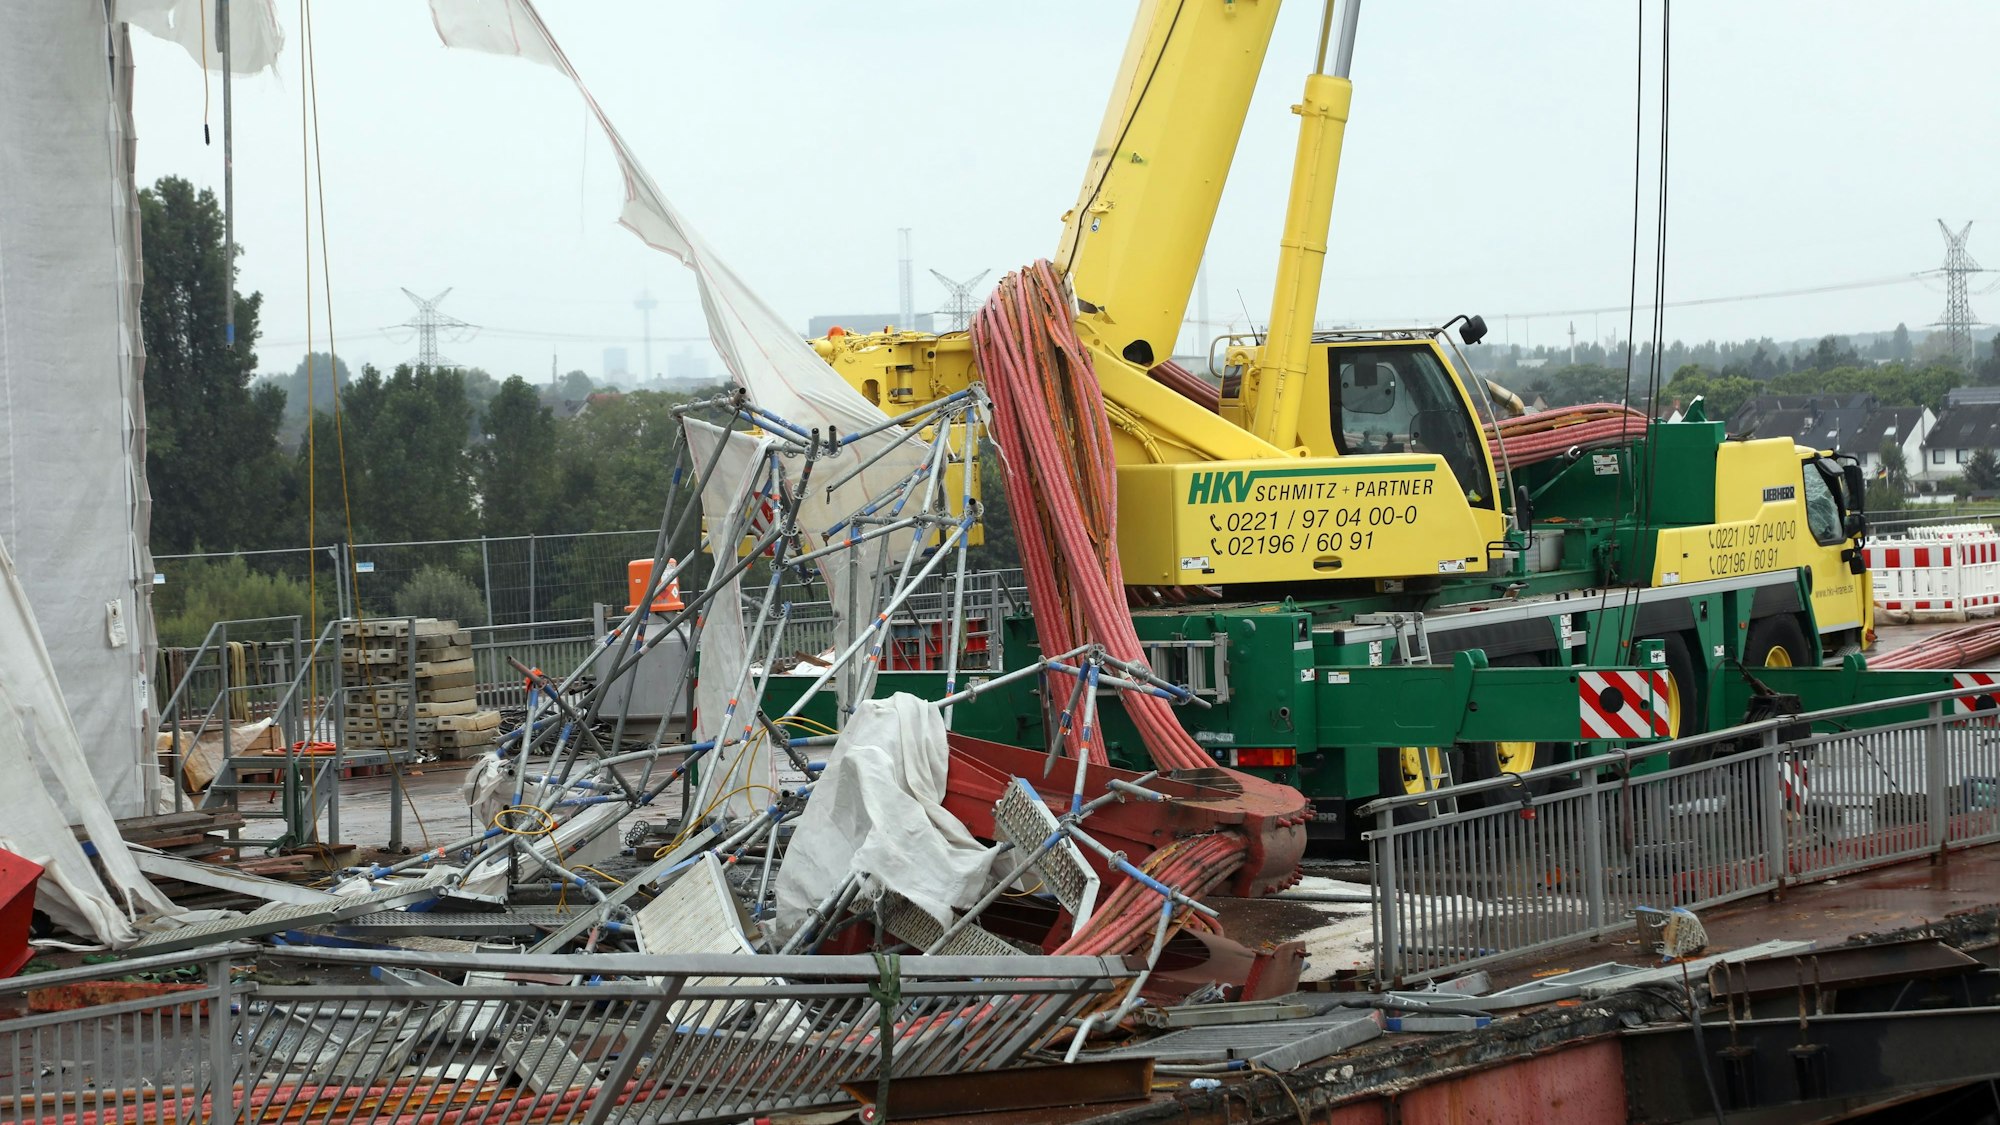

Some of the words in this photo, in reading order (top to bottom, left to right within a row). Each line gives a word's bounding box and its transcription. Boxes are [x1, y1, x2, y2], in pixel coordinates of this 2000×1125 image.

[1188, 471, 1255, 504] HKV
[1255, 483, 1337, 501] SCHMITZ
[1342, 486, 1350, 495] +
[1355, 479, 1433, 498] PARTNER
[1763, 486, 1795, 501] LIEBHERR
[1227, 512, 1278, 532] 0221
[1287, 510, 1296, 530] /
[1302, 510, 1329, 529] 97
[1336, 508, 1361, 527] 04
[1369, 506, 1417, 526] 00-0
[1228, 535, 1295, 556] 02196
[1301, 533, 1310, 553] /
[1316, 533, 1343, 552] 60
[1350, 531, 1373, 551] 91
[1715, 526, 1739, 549] 0221
[1748, 525, 1761, 546] 97
[1763, 523, 1774, 544] 04
[1775, 520, 1796, 542] 00-0
[1716, 552, 1746, 574] 02196
[1754, 550, 1766, 570] 60
[1767, 547, 1779, 568] 91
